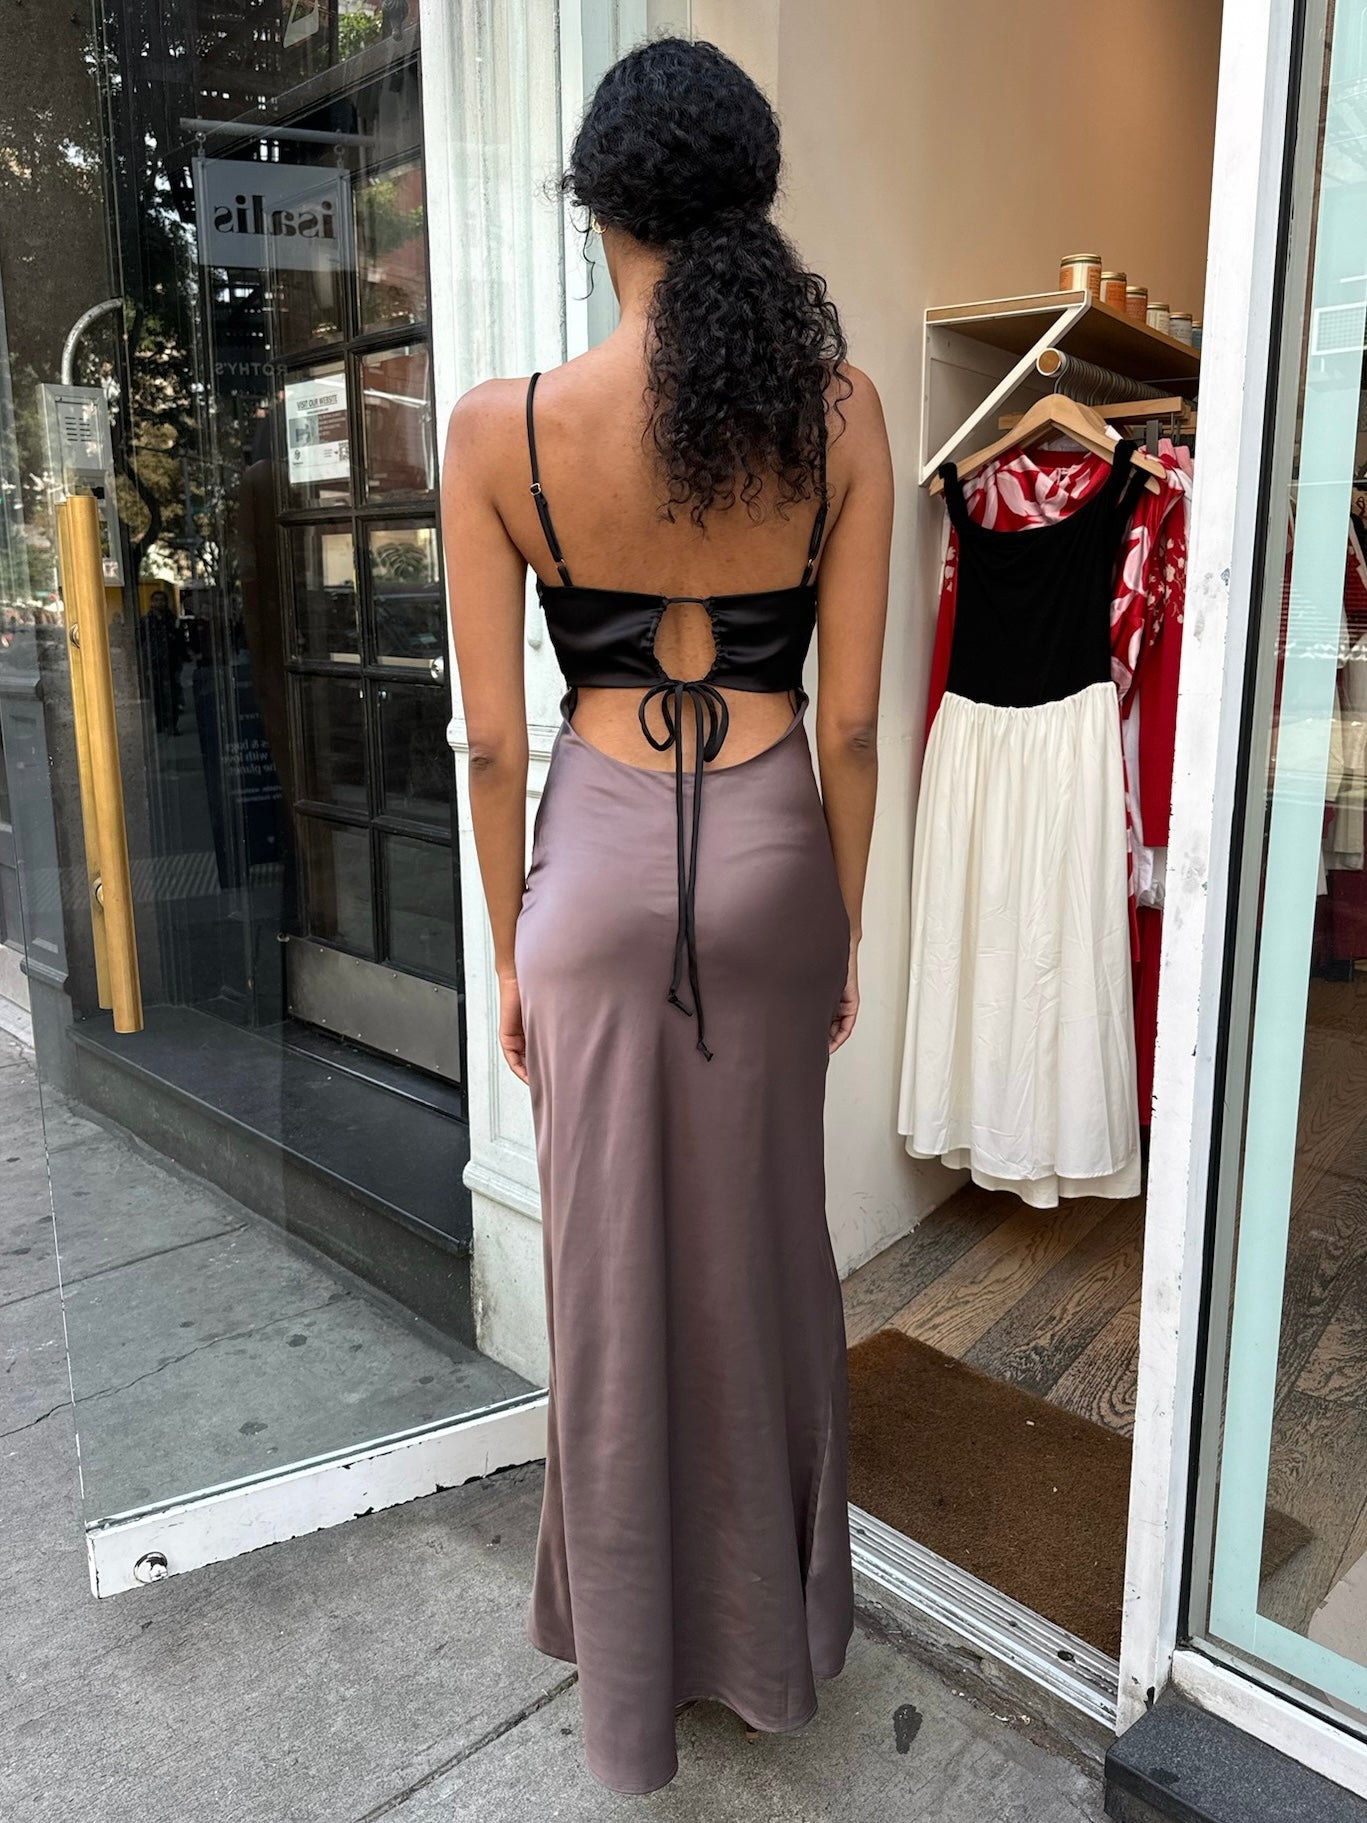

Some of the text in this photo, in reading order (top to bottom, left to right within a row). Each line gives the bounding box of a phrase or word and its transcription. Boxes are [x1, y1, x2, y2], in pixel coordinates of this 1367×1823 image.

[297, 395, 338, 409] VISIT OUR WEBSITE
